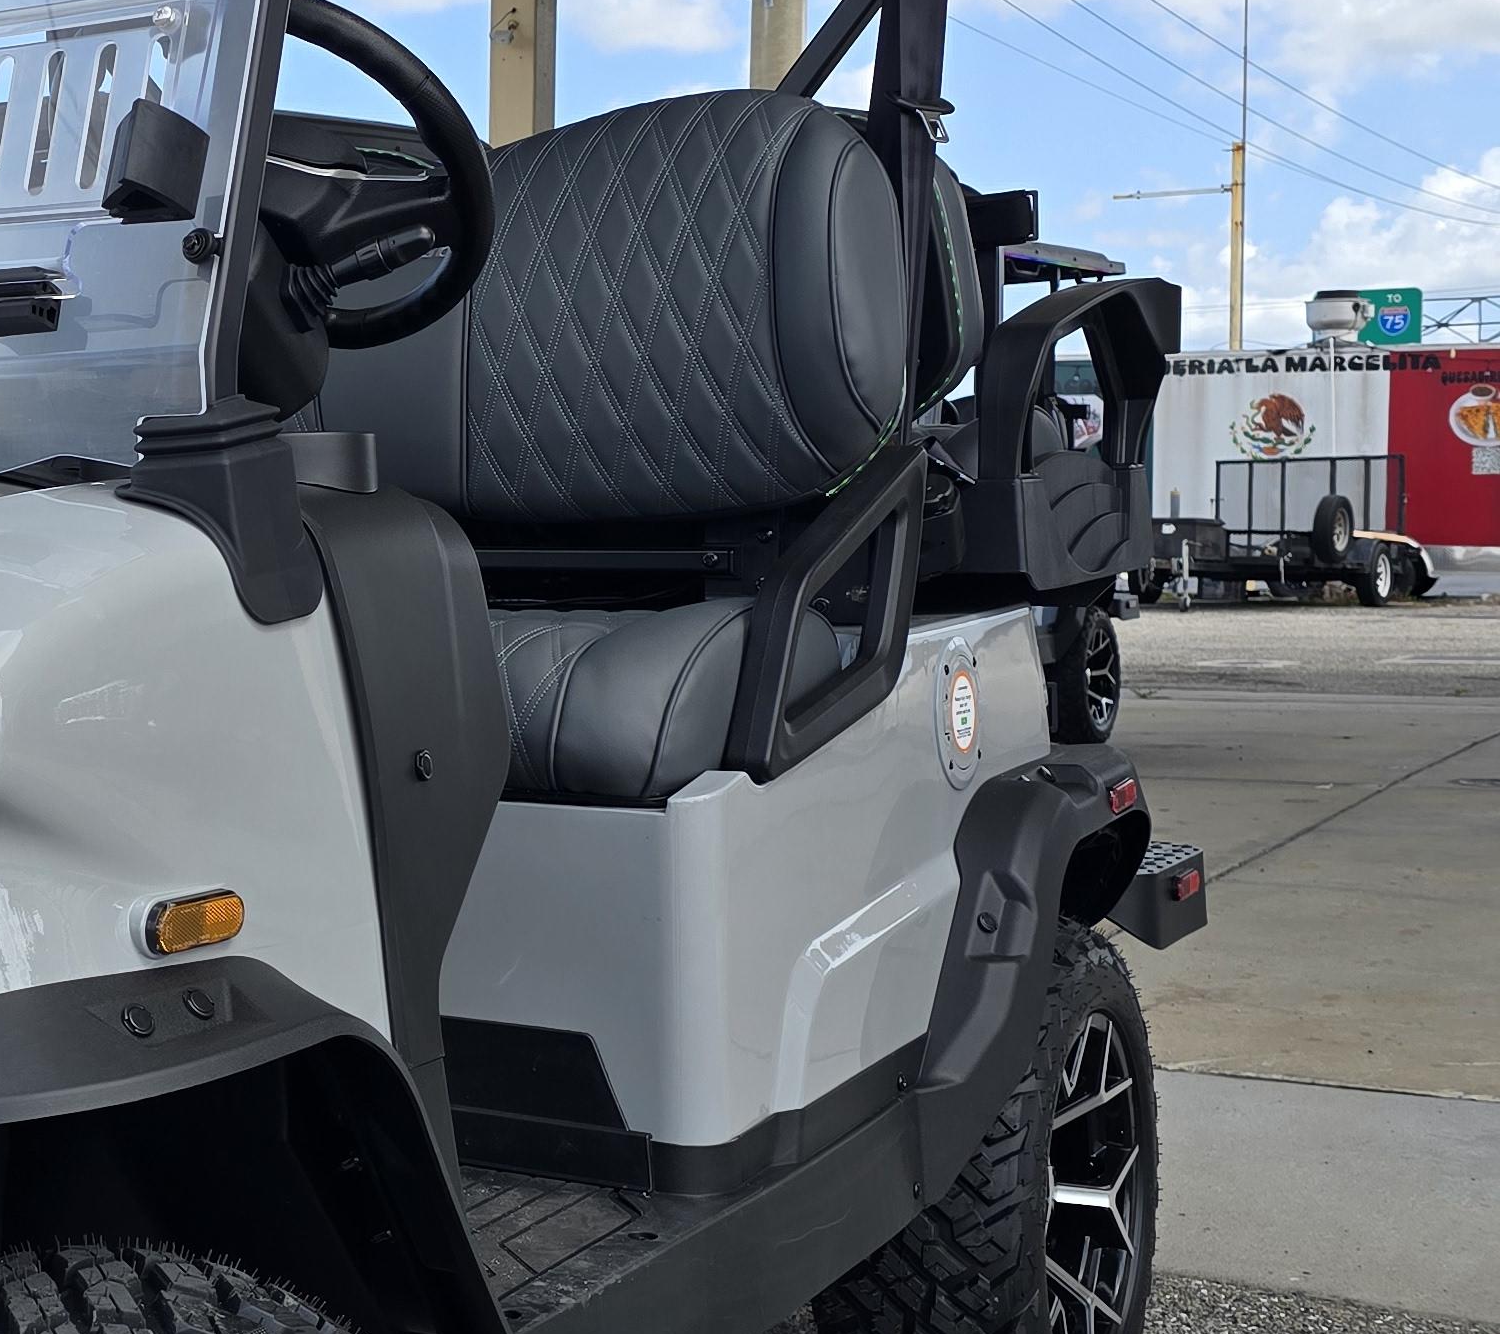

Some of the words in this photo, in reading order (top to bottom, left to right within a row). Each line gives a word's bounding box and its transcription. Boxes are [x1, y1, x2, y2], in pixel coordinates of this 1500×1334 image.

[1386, 294, 1402, 303] TO
[1383, 315, 1405, 330] 75
[1245, 358, 1279, 373] LA
[1285, 354, 1442, 373] MARCELITA
